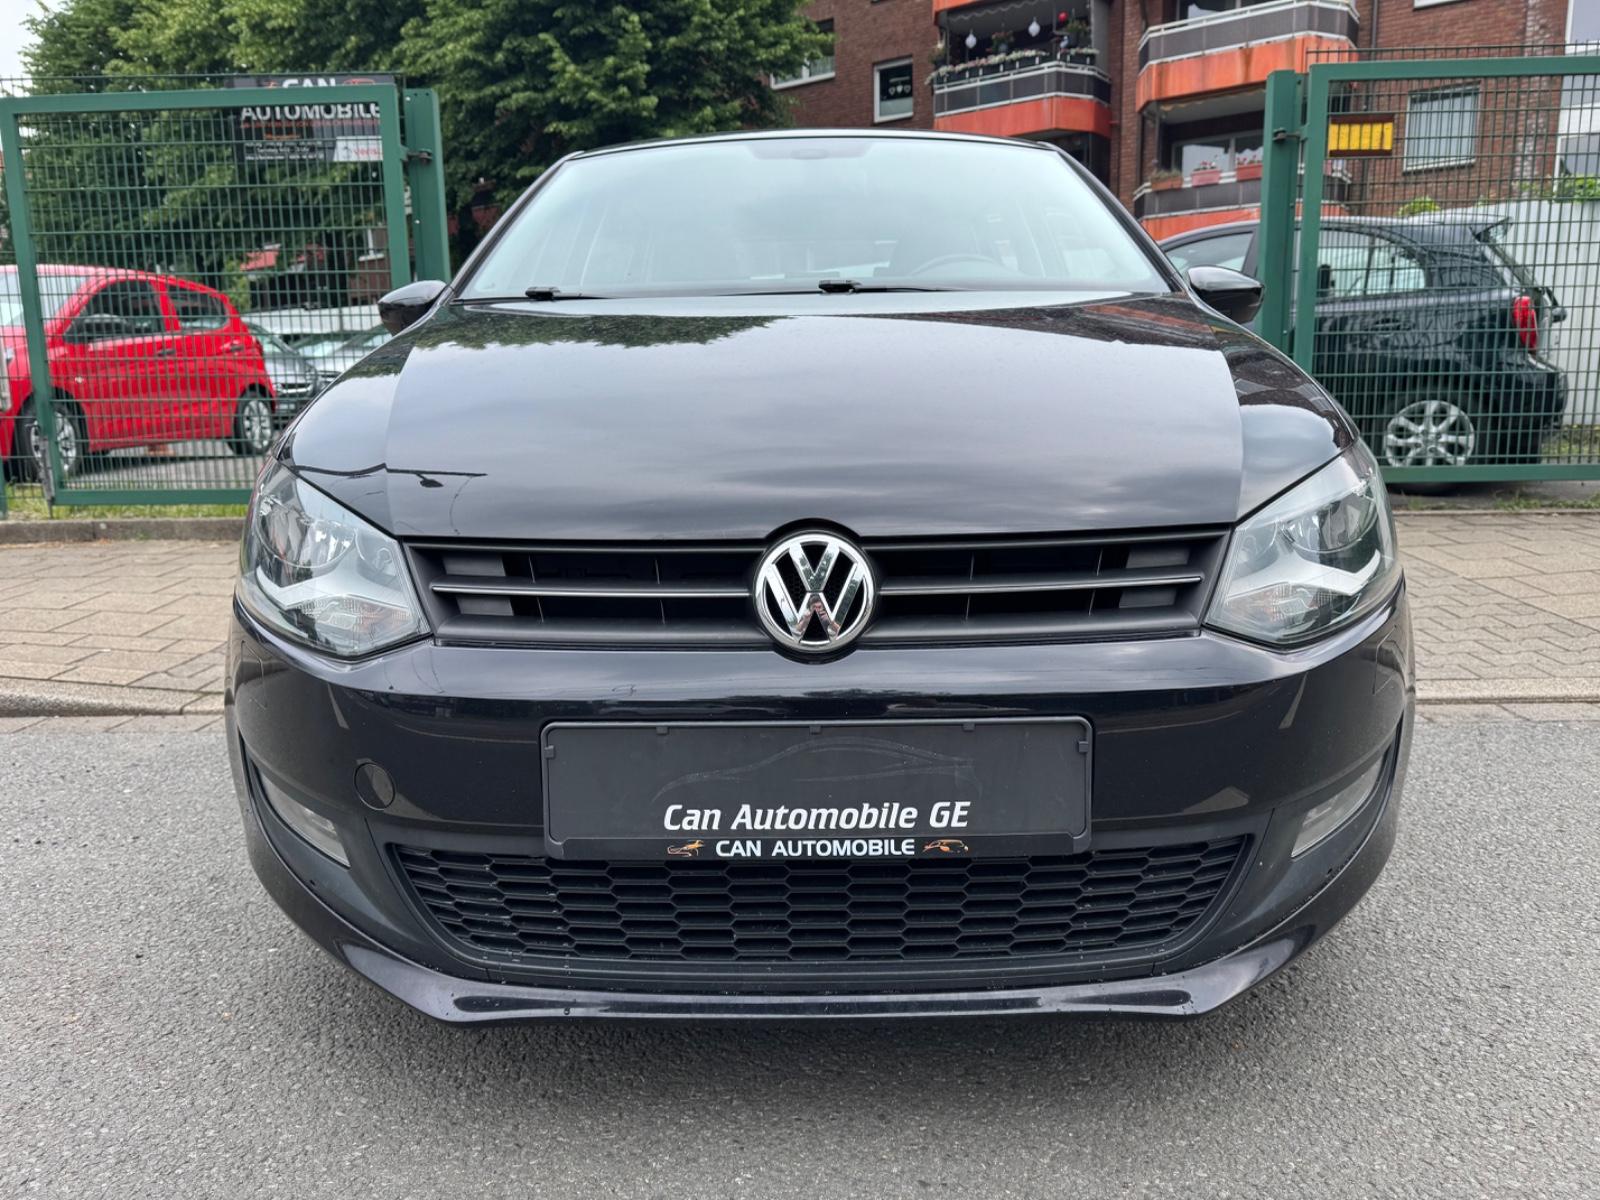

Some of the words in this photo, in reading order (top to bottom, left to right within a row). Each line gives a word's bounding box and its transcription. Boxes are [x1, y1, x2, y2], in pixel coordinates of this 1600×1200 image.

[757, 535, 872, 650] VW
[663, 804, 722, 831] Can
[730, 802, 919, 831] Automobile
[928, 801, 972, 828] GE
[715, 840, 762, 857] CAN
[771, 838, 915, 857] AUTOMOBILE
